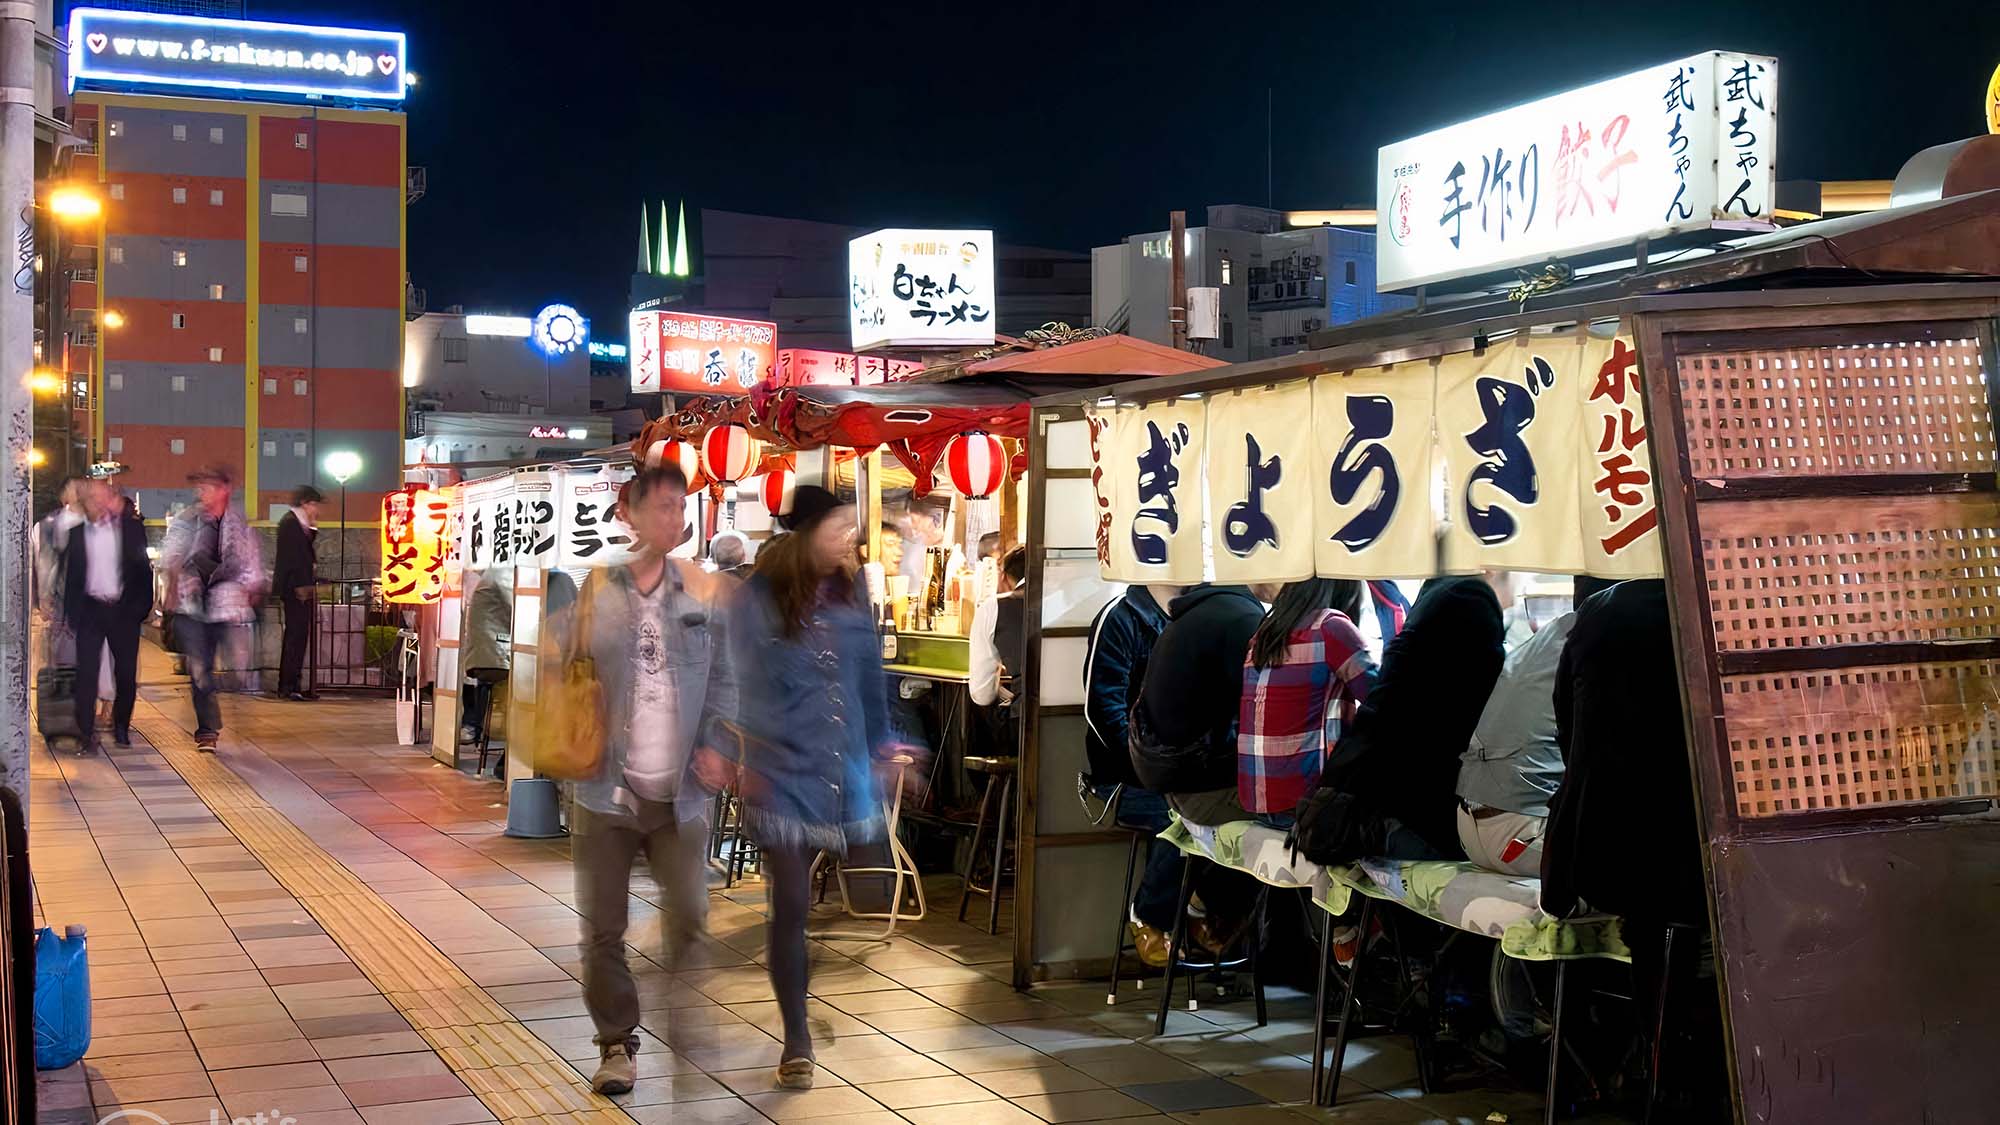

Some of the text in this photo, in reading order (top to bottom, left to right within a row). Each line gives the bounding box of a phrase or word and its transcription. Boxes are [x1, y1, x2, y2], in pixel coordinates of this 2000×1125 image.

[1439, 114, 1639, 250] 手作り餃子
[1663, 67, 1695, 223] 武ちゃん
[1723, 59, 1765, 218] 武ちゃん
[893, 263, 975, 301] 白ちゃん
[909, 300, 990, 327] ラーメン
[636, 316, 654, 385] ラーメン
[781, 353, 791, 387] ラーメ
[1590, 340, 1658, 555] ホルモン
